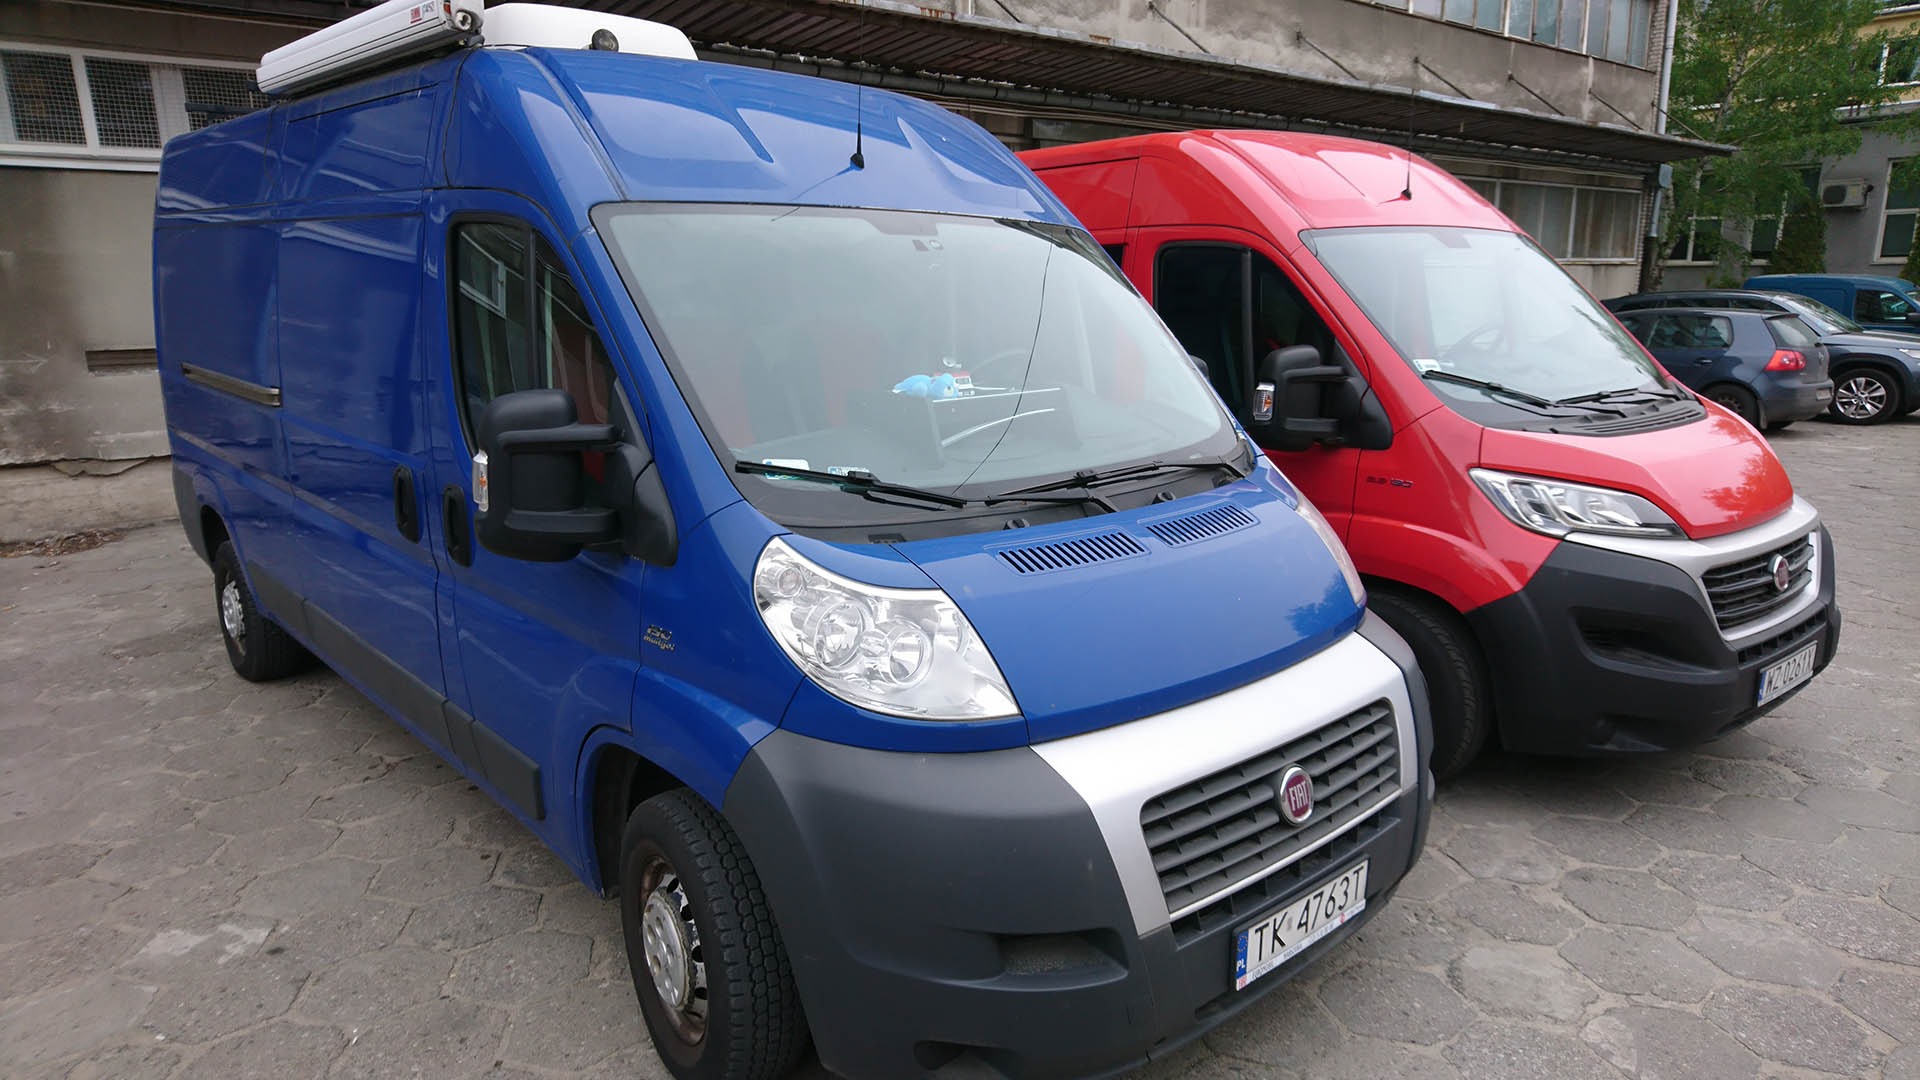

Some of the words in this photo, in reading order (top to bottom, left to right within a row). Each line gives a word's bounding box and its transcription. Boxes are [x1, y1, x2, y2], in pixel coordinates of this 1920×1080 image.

[1288, 780, 1308, 811] FIAT
[1254, 911, 1288, 962] TK
[1296, 865, 1364, 934] 4763T
[1236, 958, 1246, 972] PL
